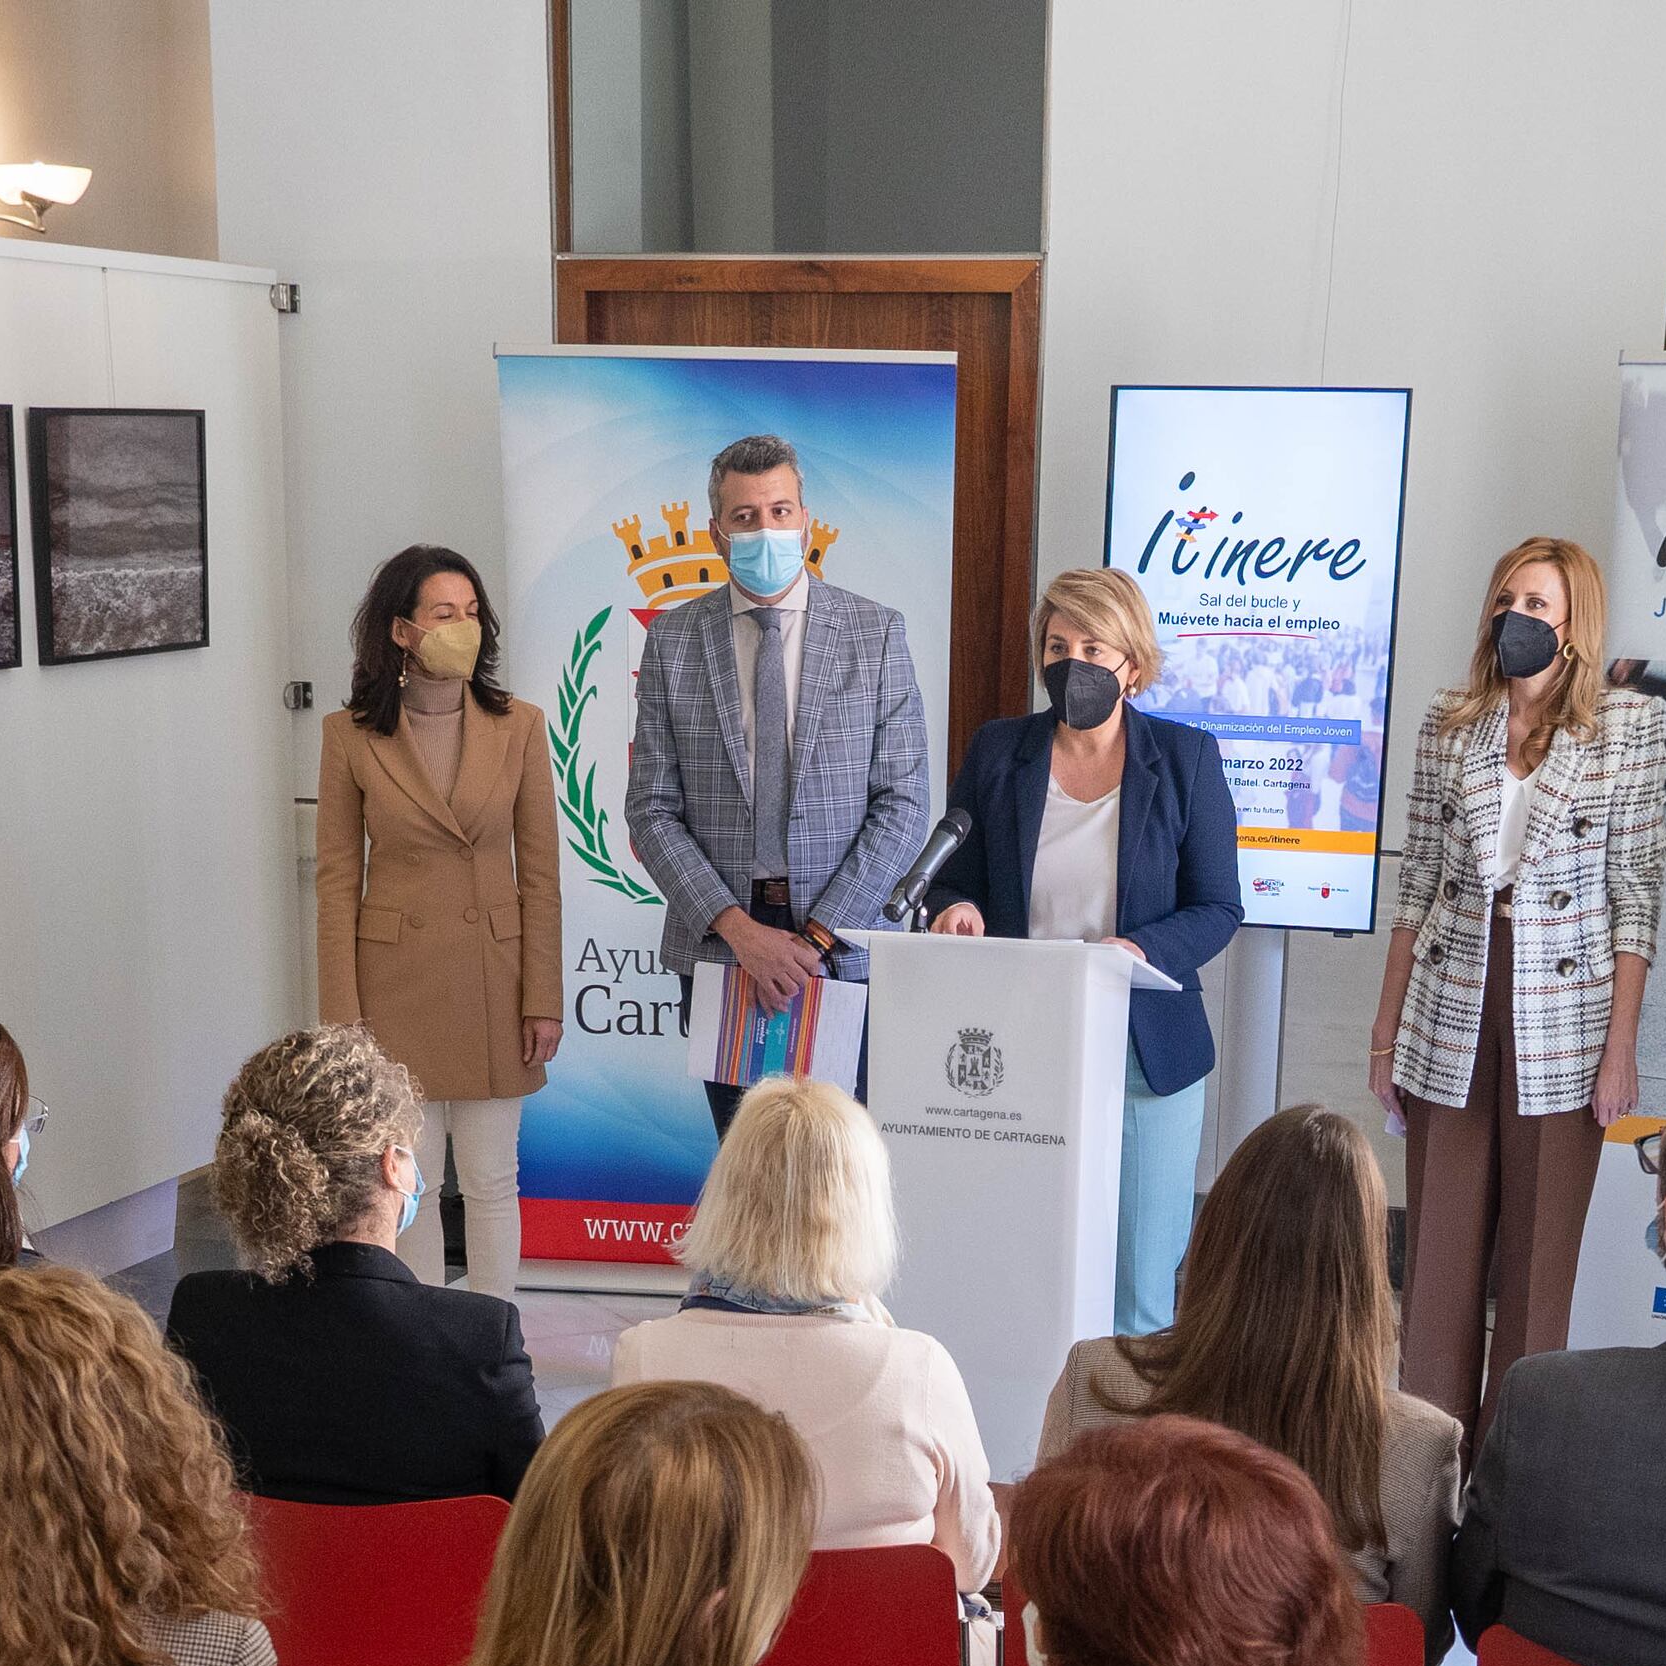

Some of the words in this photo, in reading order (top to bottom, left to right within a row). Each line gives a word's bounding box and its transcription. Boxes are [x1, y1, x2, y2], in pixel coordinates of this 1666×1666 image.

[1137, 471, 1367, 586] itinere
[1199, 593, 1222, 607] Sal
[1225, 594, 1247, 608] del
[1251, 594, 1288, 609] bucle
[1292, 599, 1301, 612] y
[1158, 612, 1220, 627] Muévete
[1224, 613, 1264, 628] hacia
[1268, 615, 1281, 628] el
[1285, 616, 1341, 633] empleo
[1200, 720, 1265, 733] Dinamización
[1267, 723, 1282, 734] del
[1284, 725, 1321, 737] Empleo
[1323, 726, 1353, 737] Joven
[1222, 758, 1265, 770] marzo
[1269, 757, 1304, 771] 2022
[1263, 779, 1311, 791] Cartagena
[574, 937, 679, 984] Ayu
[925, 1105, 1022, 1121] www.cartagena.es
[881, 1122, 972, 1139] AYUNTAMIENTO
[974, 1129, 991, 1140] DE
[993, 1130, 1067, 1146] CARTAGENA
[583, 1218, 693, 1244] www.c
